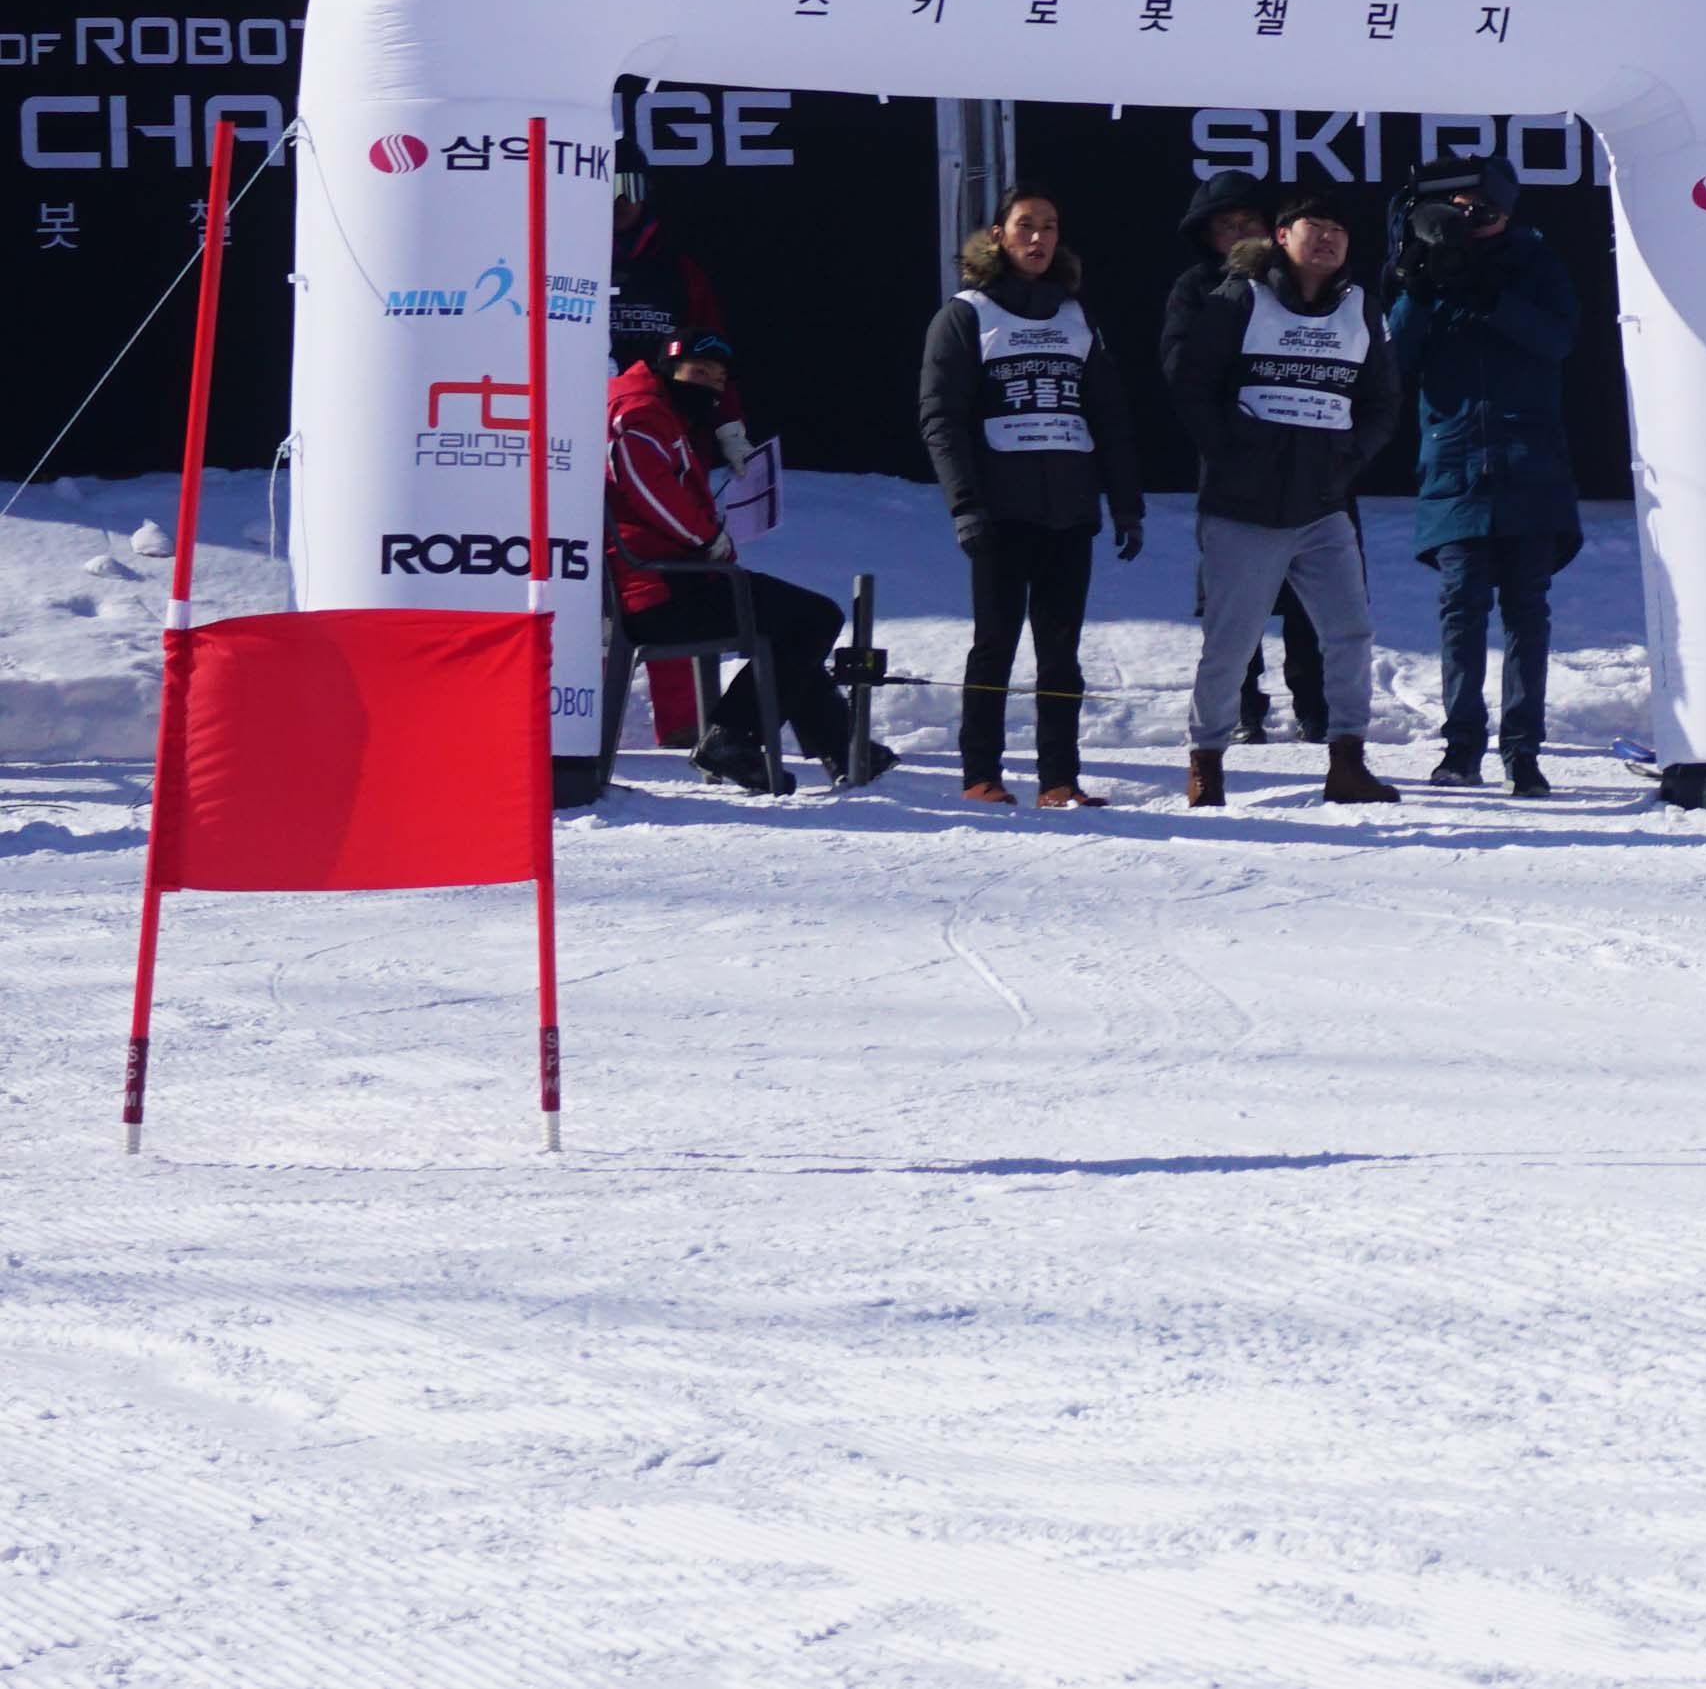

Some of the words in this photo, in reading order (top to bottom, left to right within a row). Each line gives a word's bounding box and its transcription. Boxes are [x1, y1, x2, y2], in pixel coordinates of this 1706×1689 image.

[0, 33, 61, 65] OF
[612, 91, 794, 166] GE
[1191, 109, 1383, 182] SKI
[37, 202, 80, 249] 봇
[384, 290, 467, 316] MINI
[1003, 377, 1081, 409] 루돌프
[416, 433, 572, 453] rainbw
[550, 686, 595, 718] OBOT
